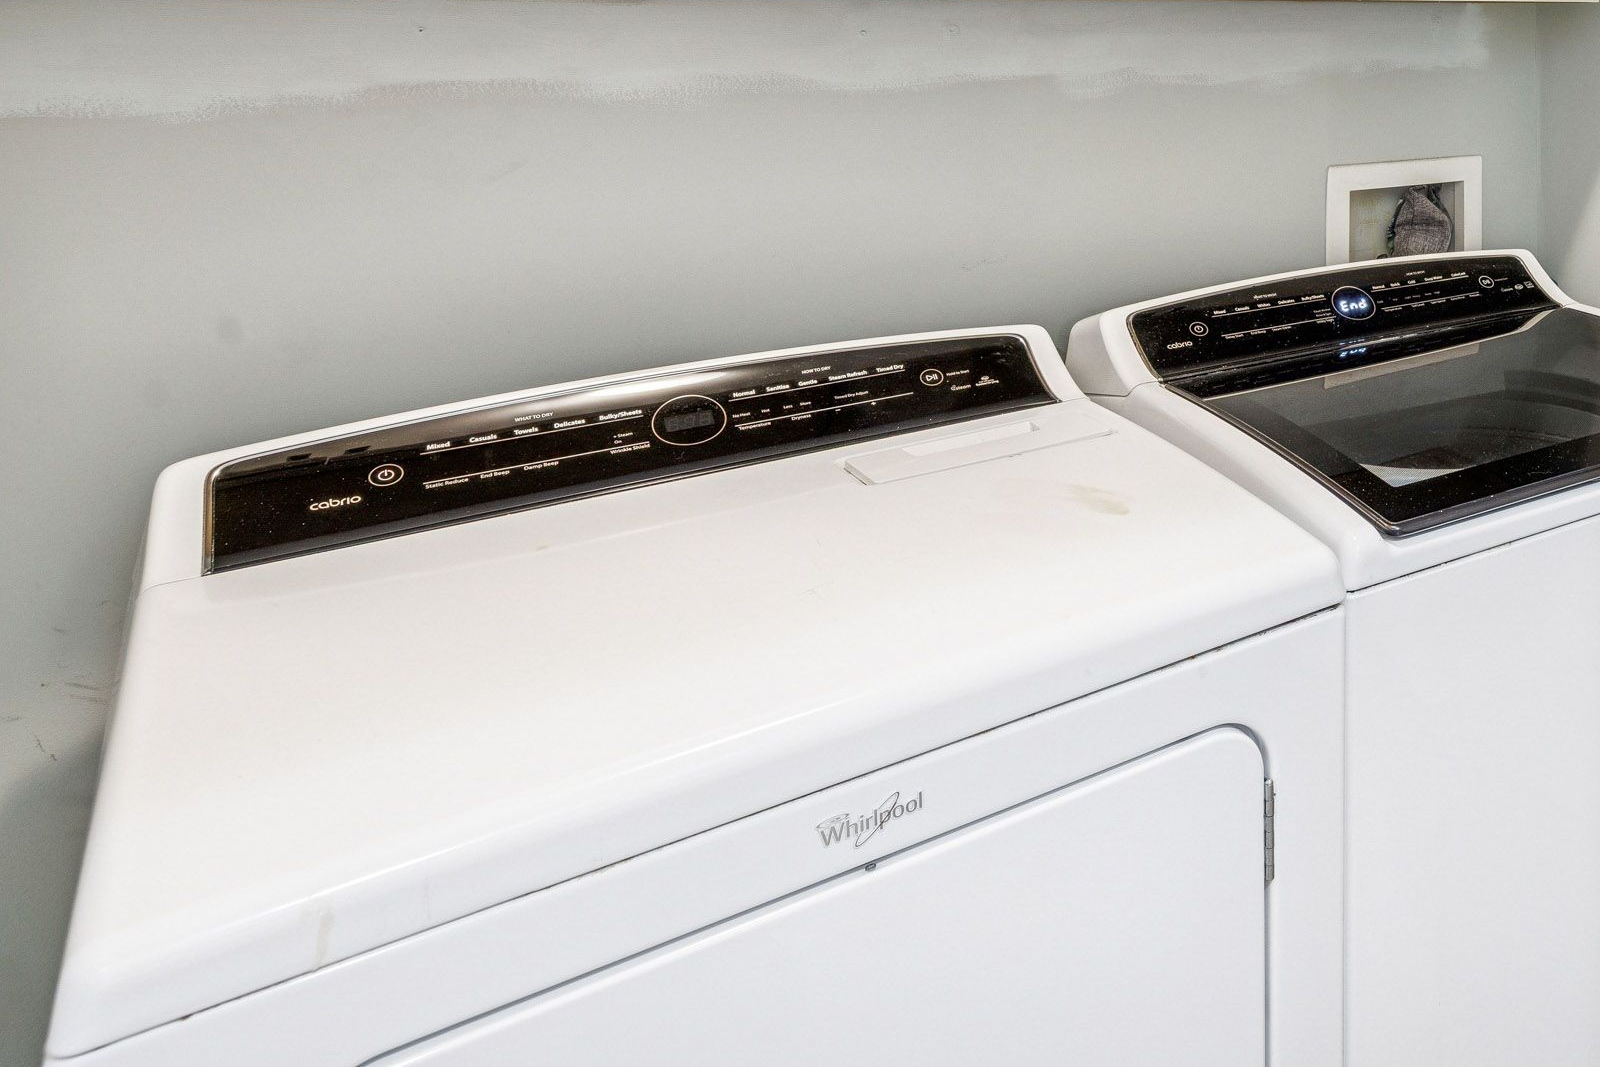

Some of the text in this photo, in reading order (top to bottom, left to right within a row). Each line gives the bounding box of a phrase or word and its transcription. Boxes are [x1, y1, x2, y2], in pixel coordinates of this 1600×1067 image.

[1339, 297, 1369, 312] End
[1166, 340, 1193, 350] cabrio
[733, 389, 756, 398] Normal
[798, 379, 818, 387] Gentle
[828, 374, 847, 382] Steam
[847, 370, 868, 379] Refresh
[876, 365, 893, 373] Timed
[514, 415, 532, 423] WHAT
[426, 441, 451, 451] Mixed
[469, 434, 498, 443] Casuals
[514, 426, 539, 435] Towels
[553, 418, 586, 429] Delicates
[425, 481, 444, 490] Static
[444, 476, 469, 487] Reduce
[480, 471, 493, 479] End
[493, 469, 510, 478] Beep
[523, 463, 543, 471] Damp
[543, 459, 559, 467] Beep
[309, 494, 362, 511] cabrio
[816, 790, 924, 848] Whirlpool
